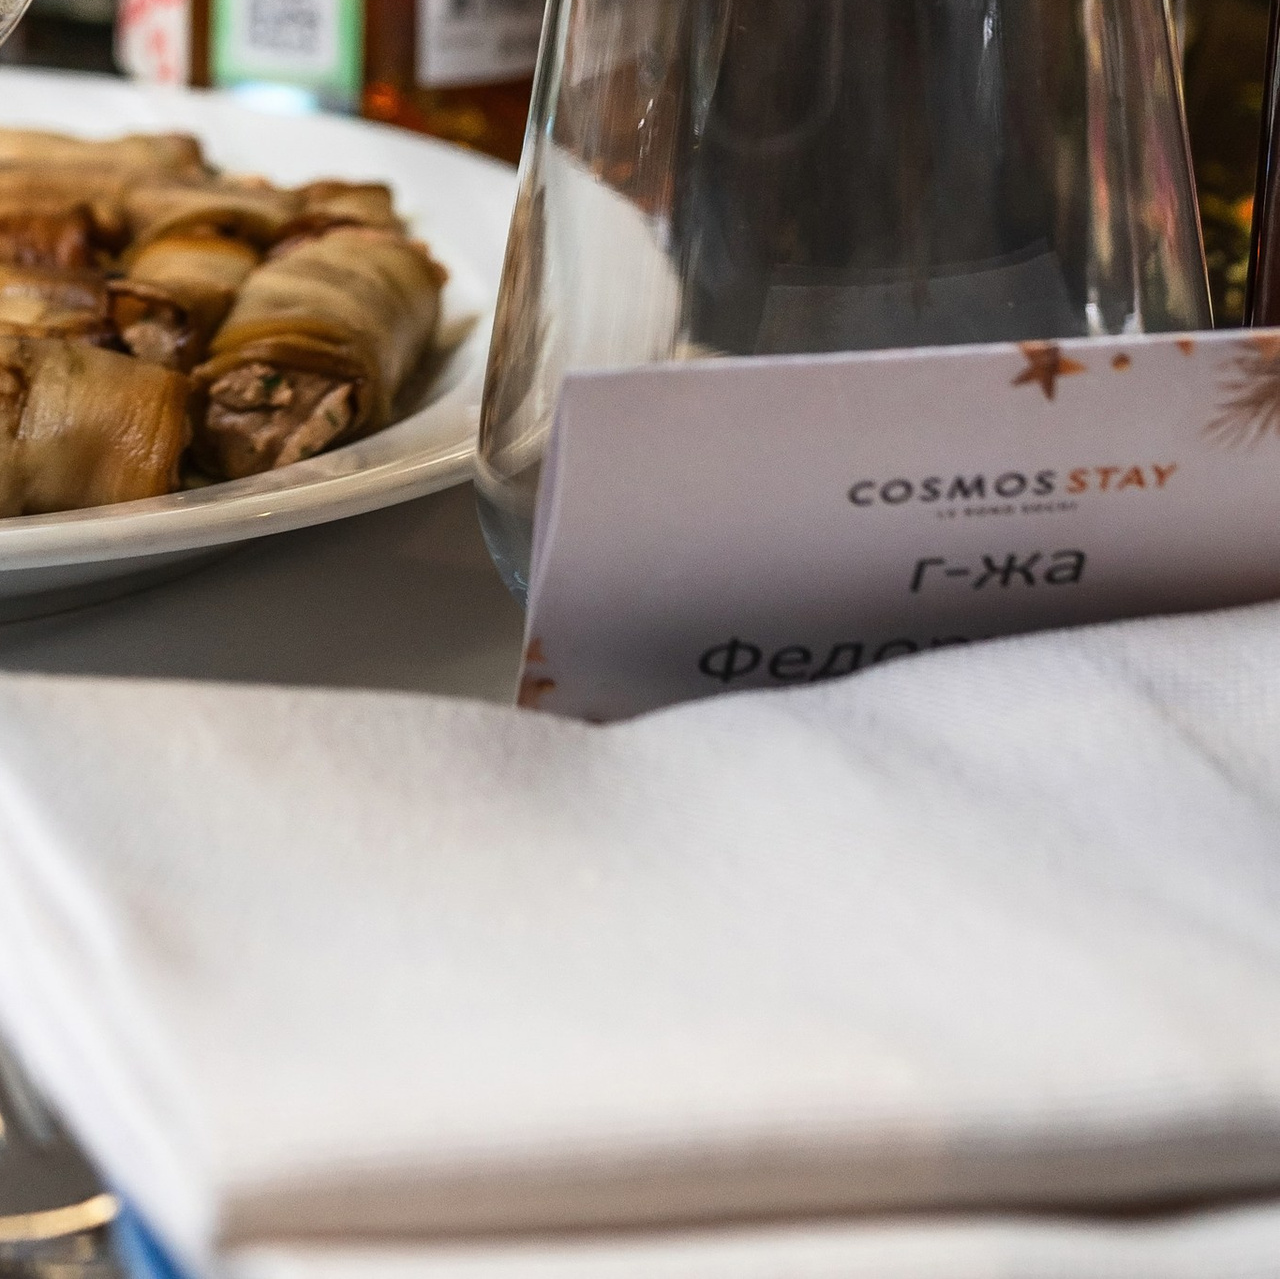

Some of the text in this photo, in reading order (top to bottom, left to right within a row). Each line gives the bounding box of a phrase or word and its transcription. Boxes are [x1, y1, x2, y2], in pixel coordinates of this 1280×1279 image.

[846, 462, 1179, 507] COSMOS STAY
[908, 548, 1088, 594] г-жа
[697, 634, 976, 684] Фед
